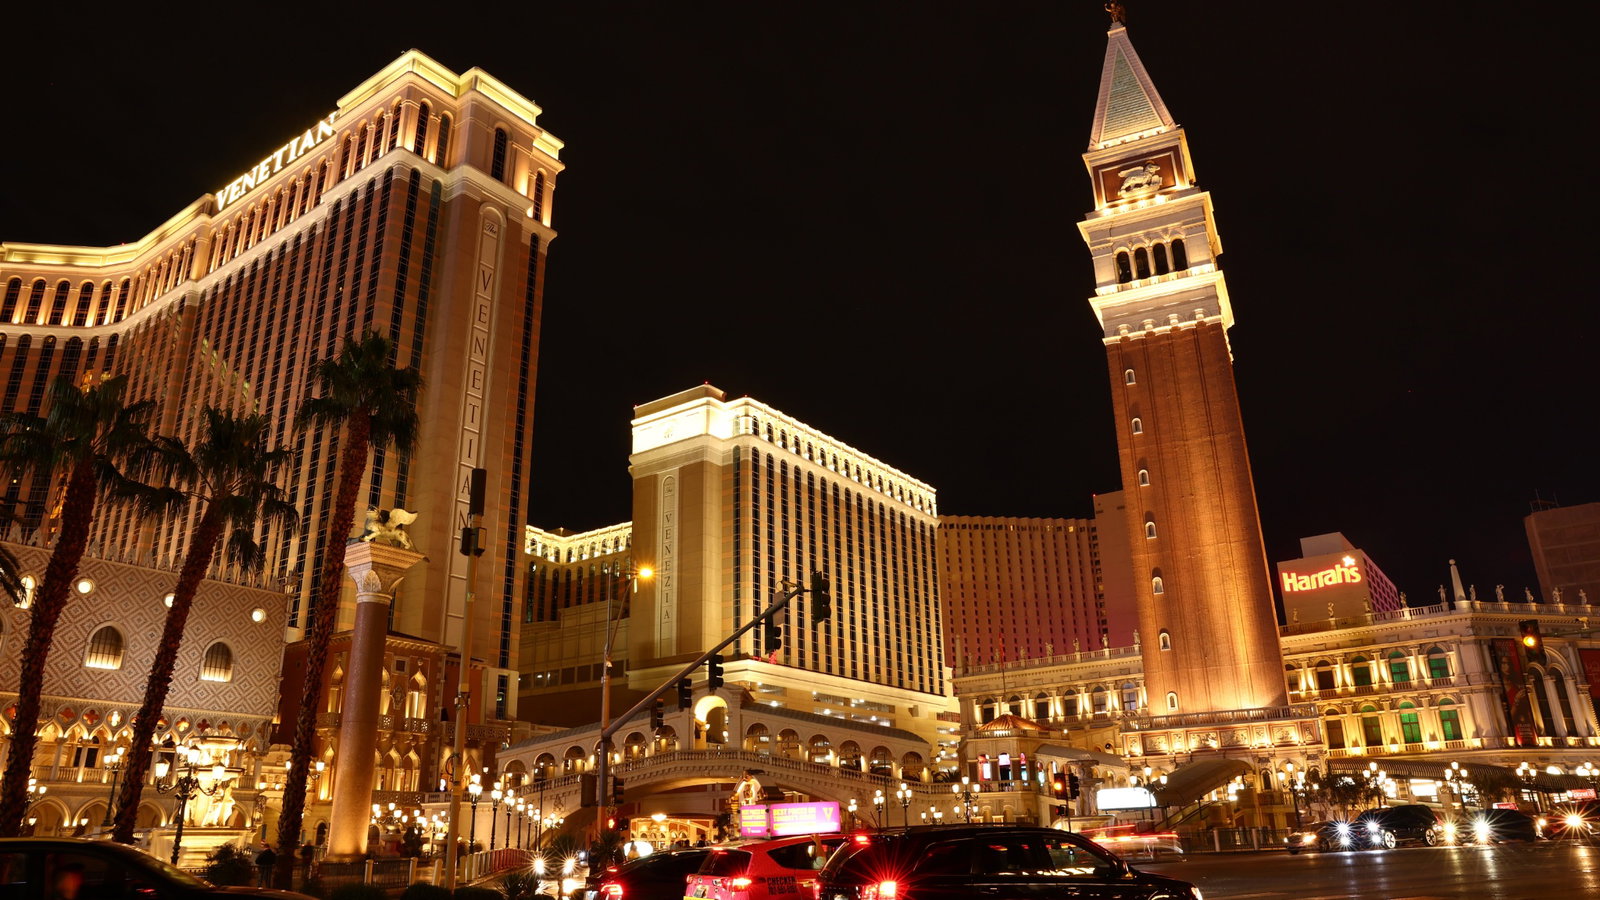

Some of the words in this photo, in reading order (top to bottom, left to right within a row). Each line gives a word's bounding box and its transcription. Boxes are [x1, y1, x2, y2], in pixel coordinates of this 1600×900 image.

[215, 111, 337, 211] VENETIAN
[484, 222, 497, 234] The
[458, 269, 492, 530] VENETIAN
[663, 512, 673, 620] VENEZIA
